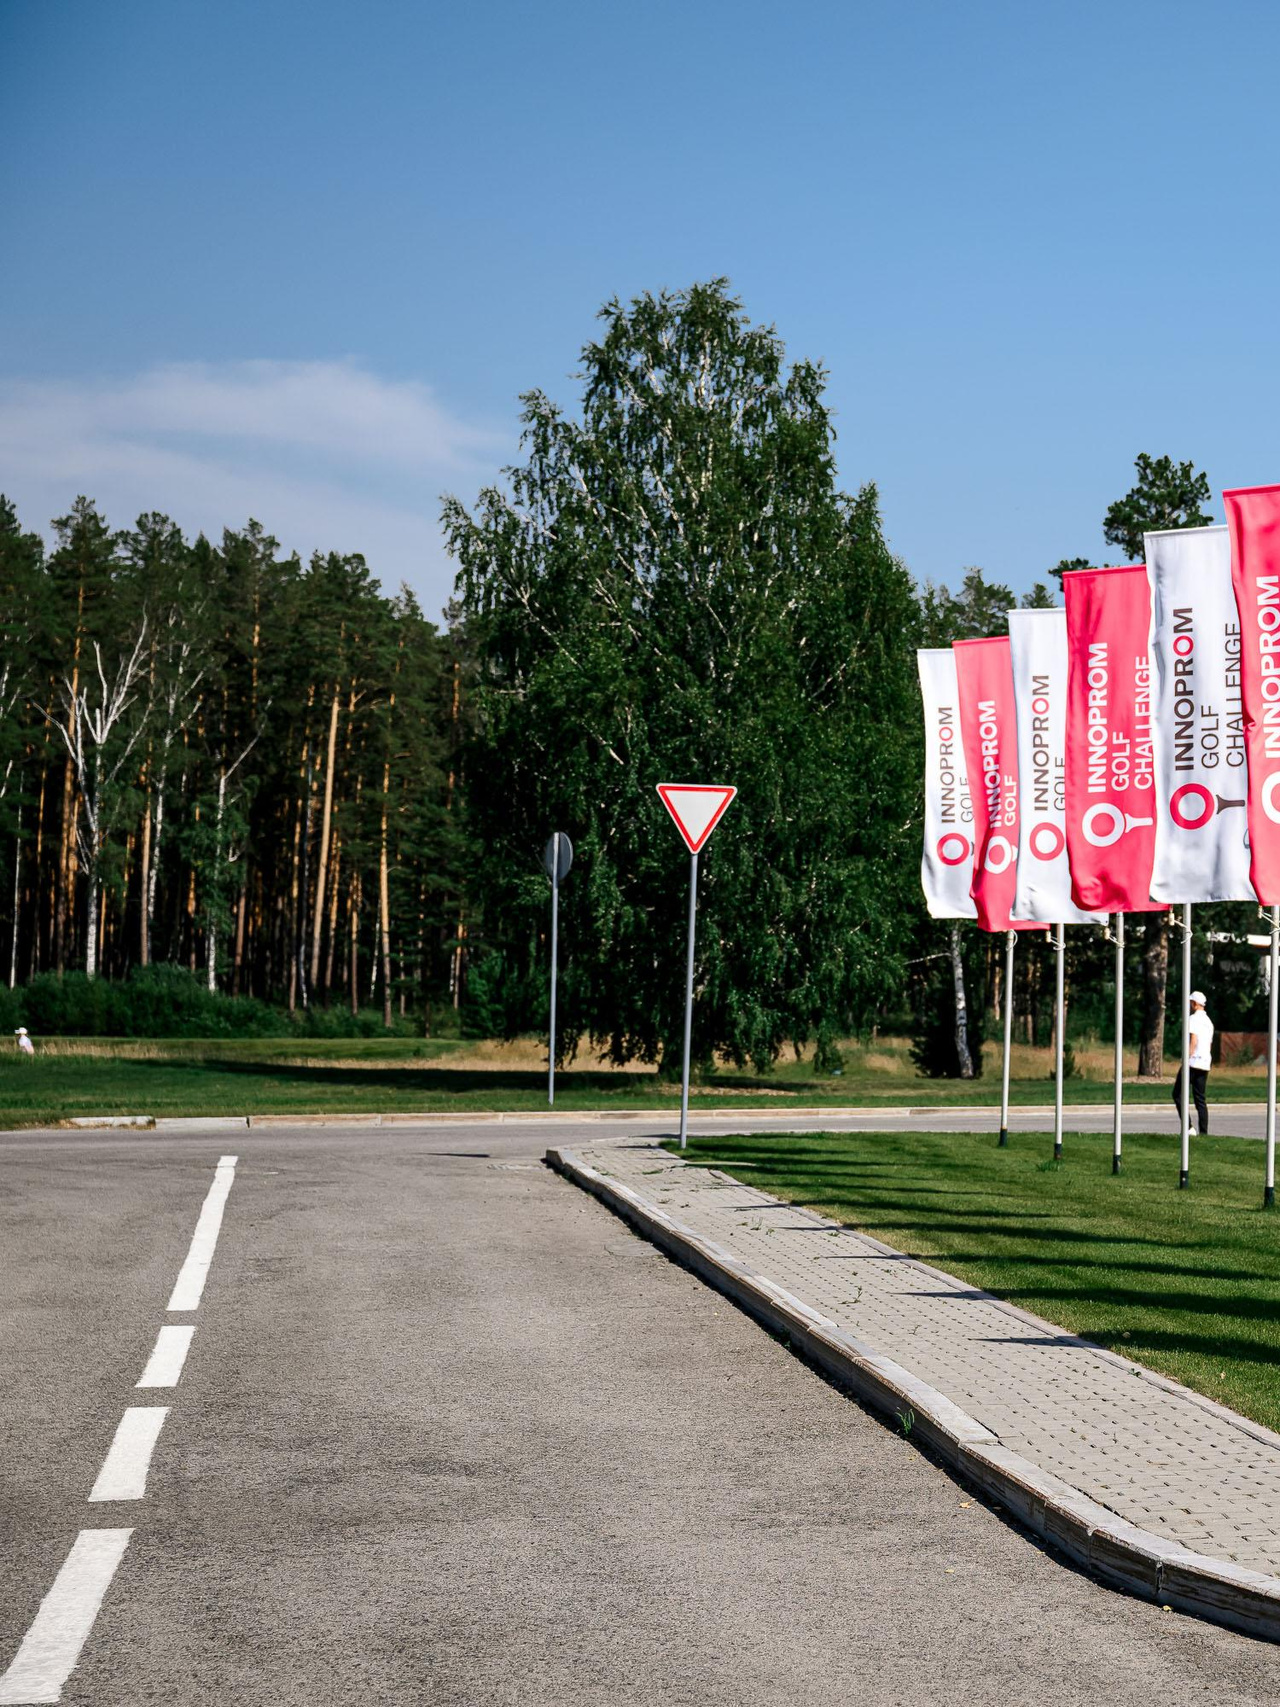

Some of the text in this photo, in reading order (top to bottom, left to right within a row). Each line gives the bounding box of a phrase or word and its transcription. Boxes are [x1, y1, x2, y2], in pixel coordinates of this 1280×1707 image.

[1032, 675, 1050, 811] INNOPROM
[1087, 642, 1108, 793] INNOPROM
[1134, 656, 1152, 790] CHALLENGE
[1172, 607, 1195, 771] INNOPROM
[1201, 705, 1219, 769] GOLF
[937, 706, 956, 824] INNOPROM
[977, 700, 1002, 829] INNOPROM
[1004, 775, 1018, 827] GOLF
[1111, 731, 1130, 791] GOLF
